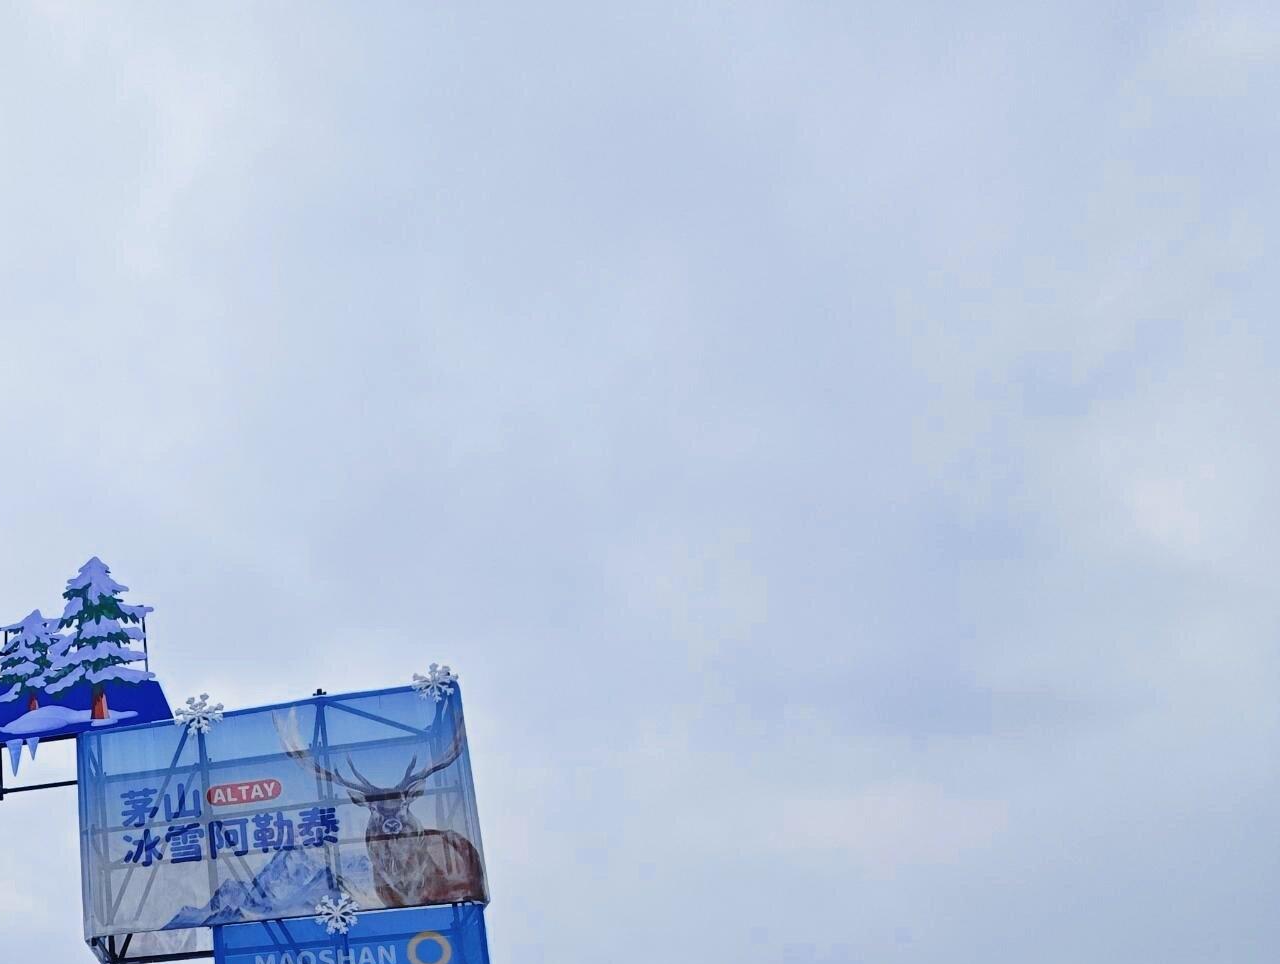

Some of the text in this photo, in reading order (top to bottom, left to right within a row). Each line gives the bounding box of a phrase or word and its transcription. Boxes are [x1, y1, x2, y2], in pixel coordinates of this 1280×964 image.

[120, 783, 202, 829] 茅山
[211, 782, 278, 804] ALTAY
[123, 807, 341, 867] 冰雪阿勒泰
